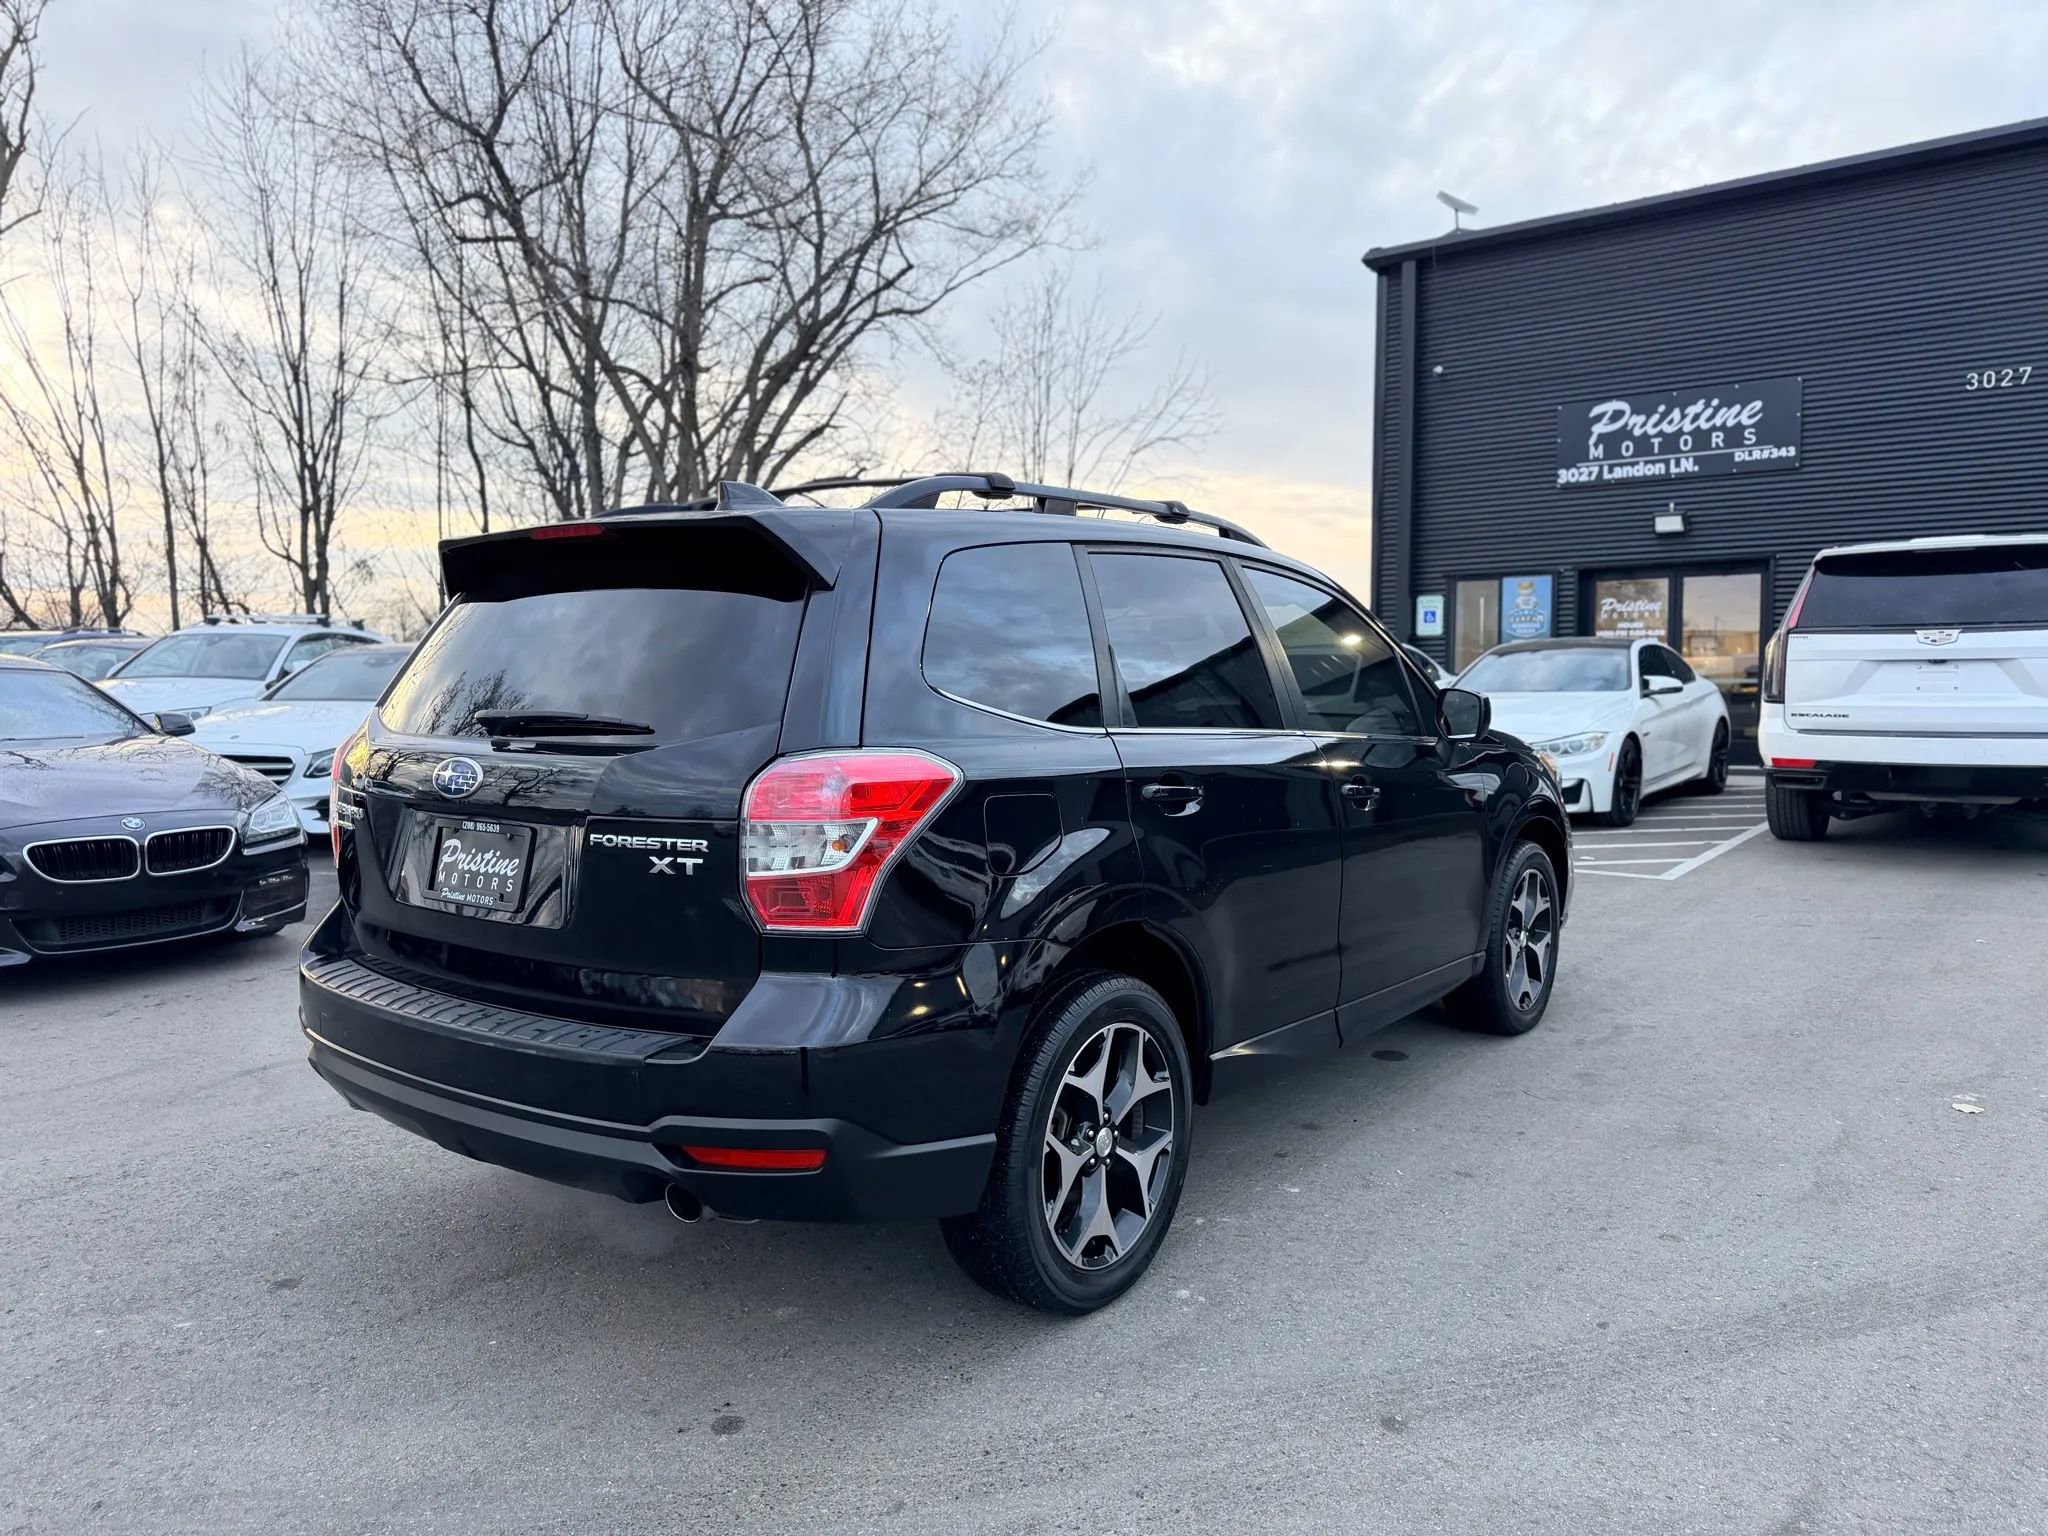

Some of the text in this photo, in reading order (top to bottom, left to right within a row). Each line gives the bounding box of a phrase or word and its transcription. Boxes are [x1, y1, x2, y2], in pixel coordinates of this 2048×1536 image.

[1965, 366, 2033, 390] 3027
[1588, 398, 1763, 446] Pristine
[1588, 428, 1757, 460] MOTORS
[1734, 446, 1797, 462] DLR#343
[1557, 457, 1699, 484] 3027 Landon LN.
[1600, 598, 1662, 617] Pristine
[589, 833, 709, 853] FORESTER
[439, 838, 520, 877] Pristine
[648, 856, 704, 876] XT
[438, 870, 514, 892] MOTORS
[440, 887, 494, 906] Pristine MOTORS
